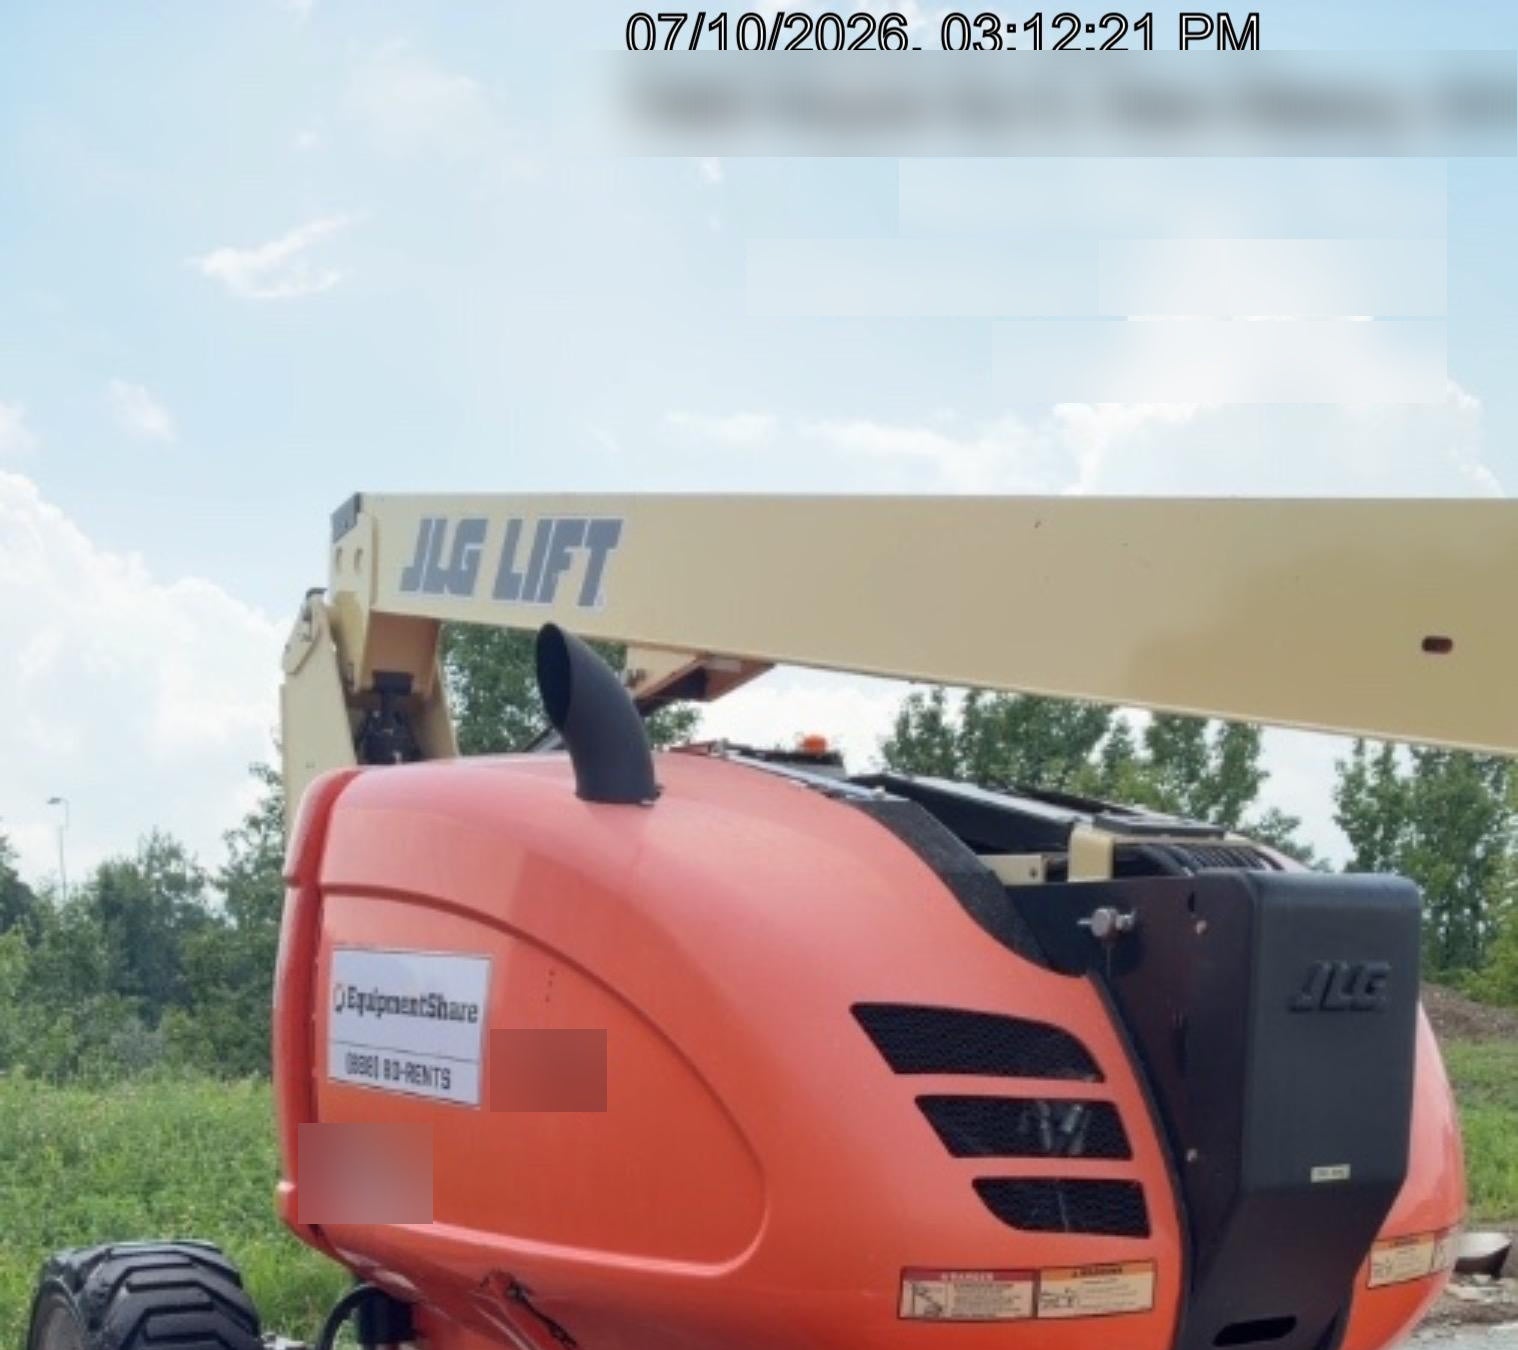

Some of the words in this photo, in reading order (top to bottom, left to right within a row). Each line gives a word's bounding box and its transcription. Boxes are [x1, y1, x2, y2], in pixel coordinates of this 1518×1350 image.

[399, 516, 491, 598] JLG
[491, 516, 625, 608] LIFT
[347, 986, 479, 1023] EquipmentShare
